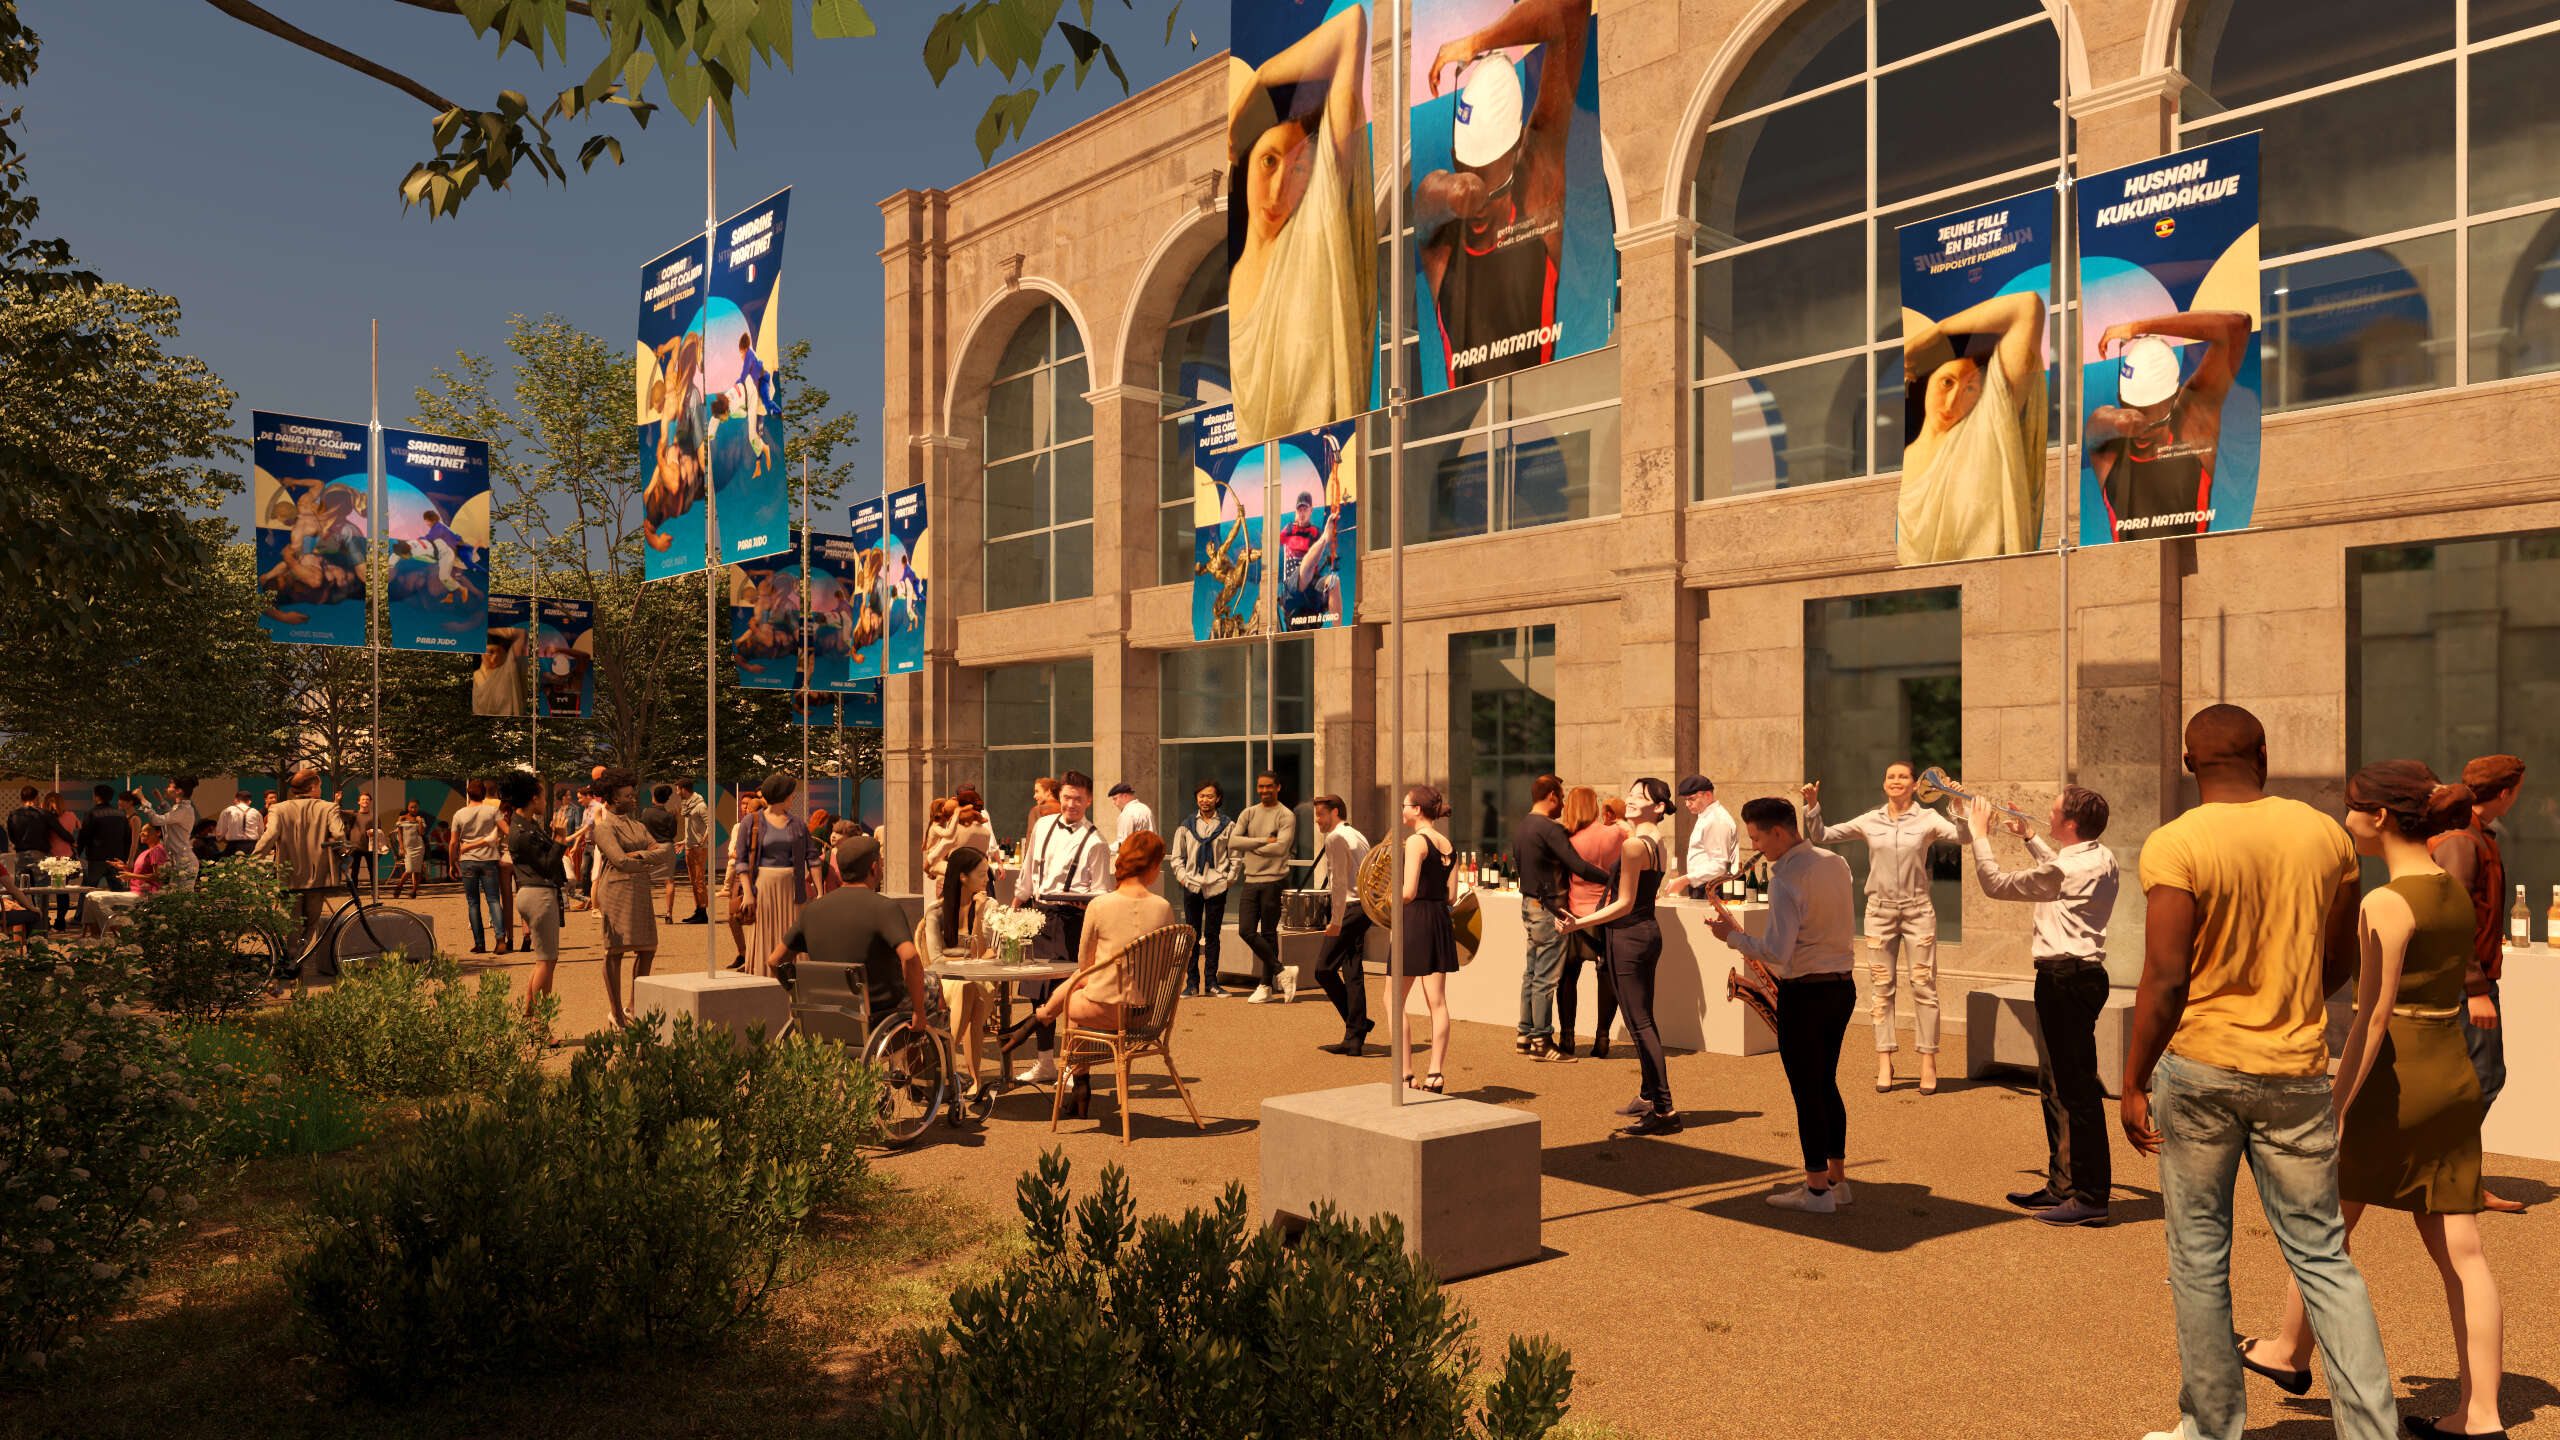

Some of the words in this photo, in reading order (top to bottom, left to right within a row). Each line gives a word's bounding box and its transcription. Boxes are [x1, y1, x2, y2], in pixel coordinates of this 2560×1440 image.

[2123, 158, 2209, 197] HUSNAH
[2095, 174, 2241, 228] KUKUNDAKWE
[730, 210, 774, 247] SANDRINE
[1937, 219, 1976, 242] JEUNE
[1976, 210, 2010, 232] FILLE
[729, 231, 773, 268] MARTINET
[1945, 239, 1962, 255] EN
[1963, 228, 2003, 251] BUSTE
[1930, 255, 1977, 275] HIPPOLYTE
[1976, 242, 2018, 262] FLANDRIN
[1450, 344, 1488, 372] PARA
[1489, 321, 1564, 360] NATATION
[289, 425, 334, 438] COMBAT
[1200, 438, 1209, 447] DU
[1210, 435, 1223, 446] LAC
[1211, 425, 1221, 435] LES
[260, 431, 274, 441] DE
[306, 437, 318, 446] ET
[319, 438, 361, 452] GOLIATH
[407, 439, 466, 457] SANDRINE
[406, 453, 466, 470] MARTINET
[2115, 517, 2150, 532] PARA
[2150, 508, 2217, 528] NATATION
[737, 539, 752, 552] PARA
[752, 535, 768, 549] JUDO
[1291, 617, 1307, 625] PARA
[415, 636, 436, 645] PARA
[436, 637, 457, 646] JUDO
